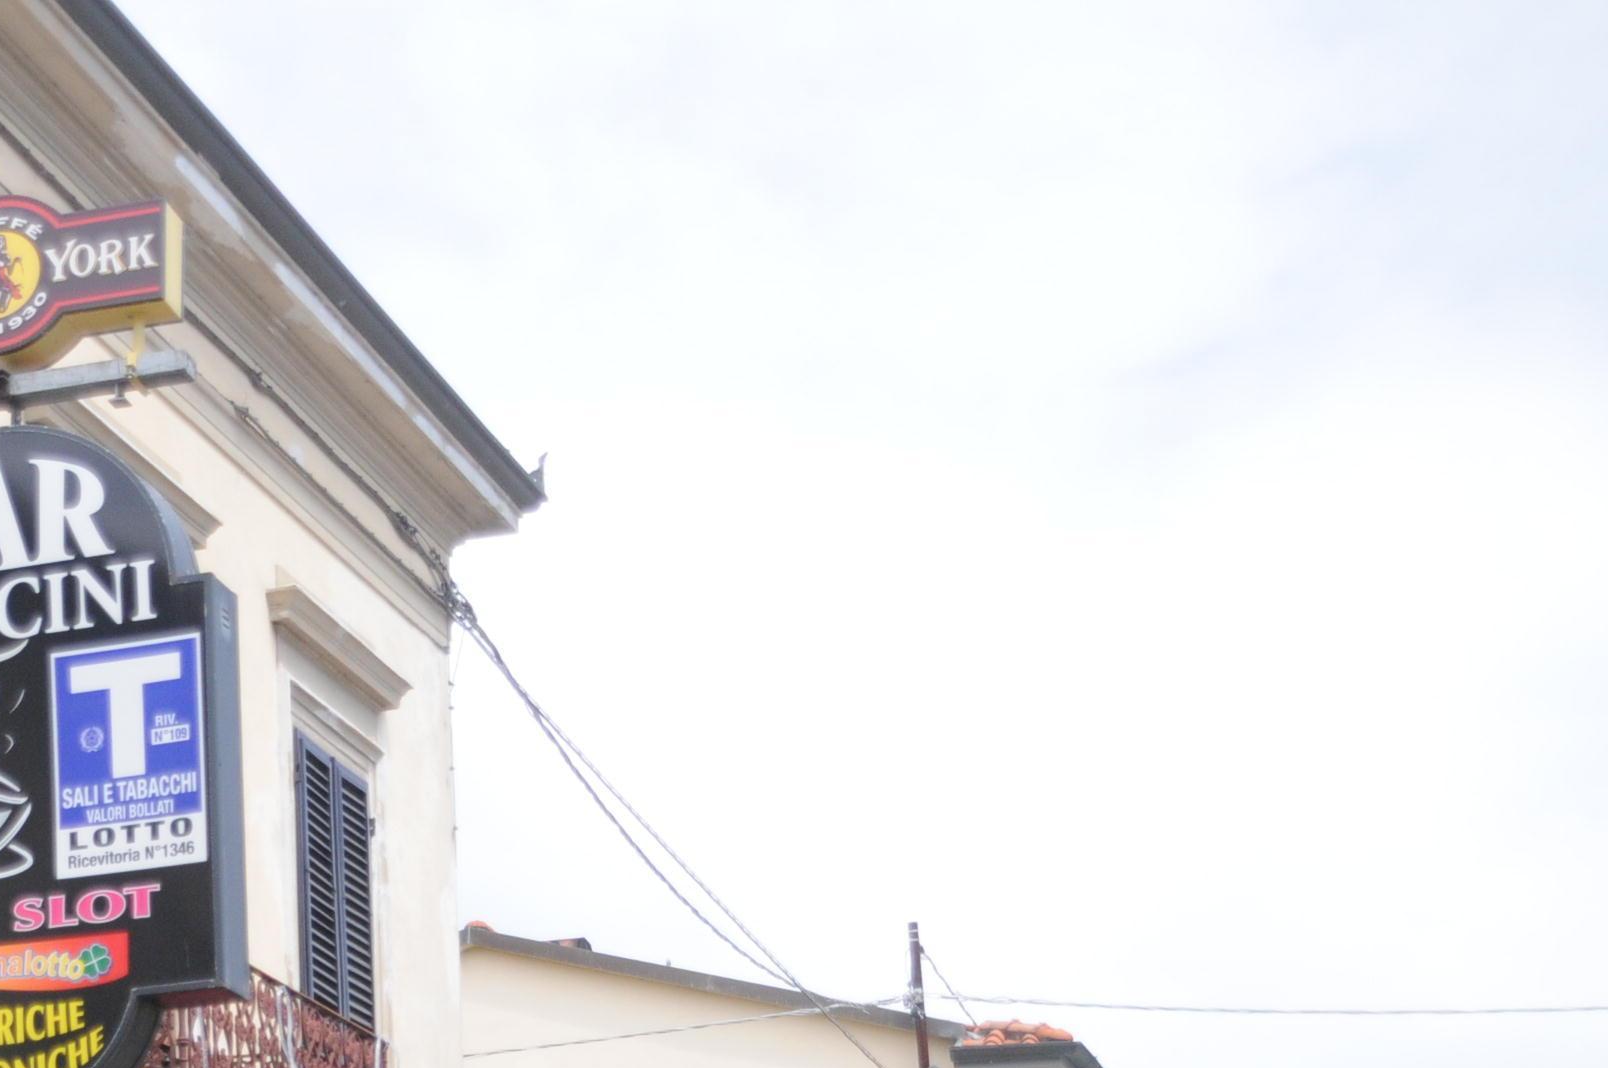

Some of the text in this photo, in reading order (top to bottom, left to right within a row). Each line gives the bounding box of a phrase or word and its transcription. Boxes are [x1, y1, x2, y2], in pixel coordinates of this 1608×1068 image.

[45, 234, 159, 282] YORK
[70, 652, 181, 779] T
[155, 713, 178, 726] RIV.
[62, 772, 196, 809] SALI E TABACCHI
[86, 799, 174, 824] VALORI BOLLATI
[69, 817, 193, 851] LOTTO
[68, 849, 140, 869] Ricevitoria
[13, 884, 161, 932] SLOT
